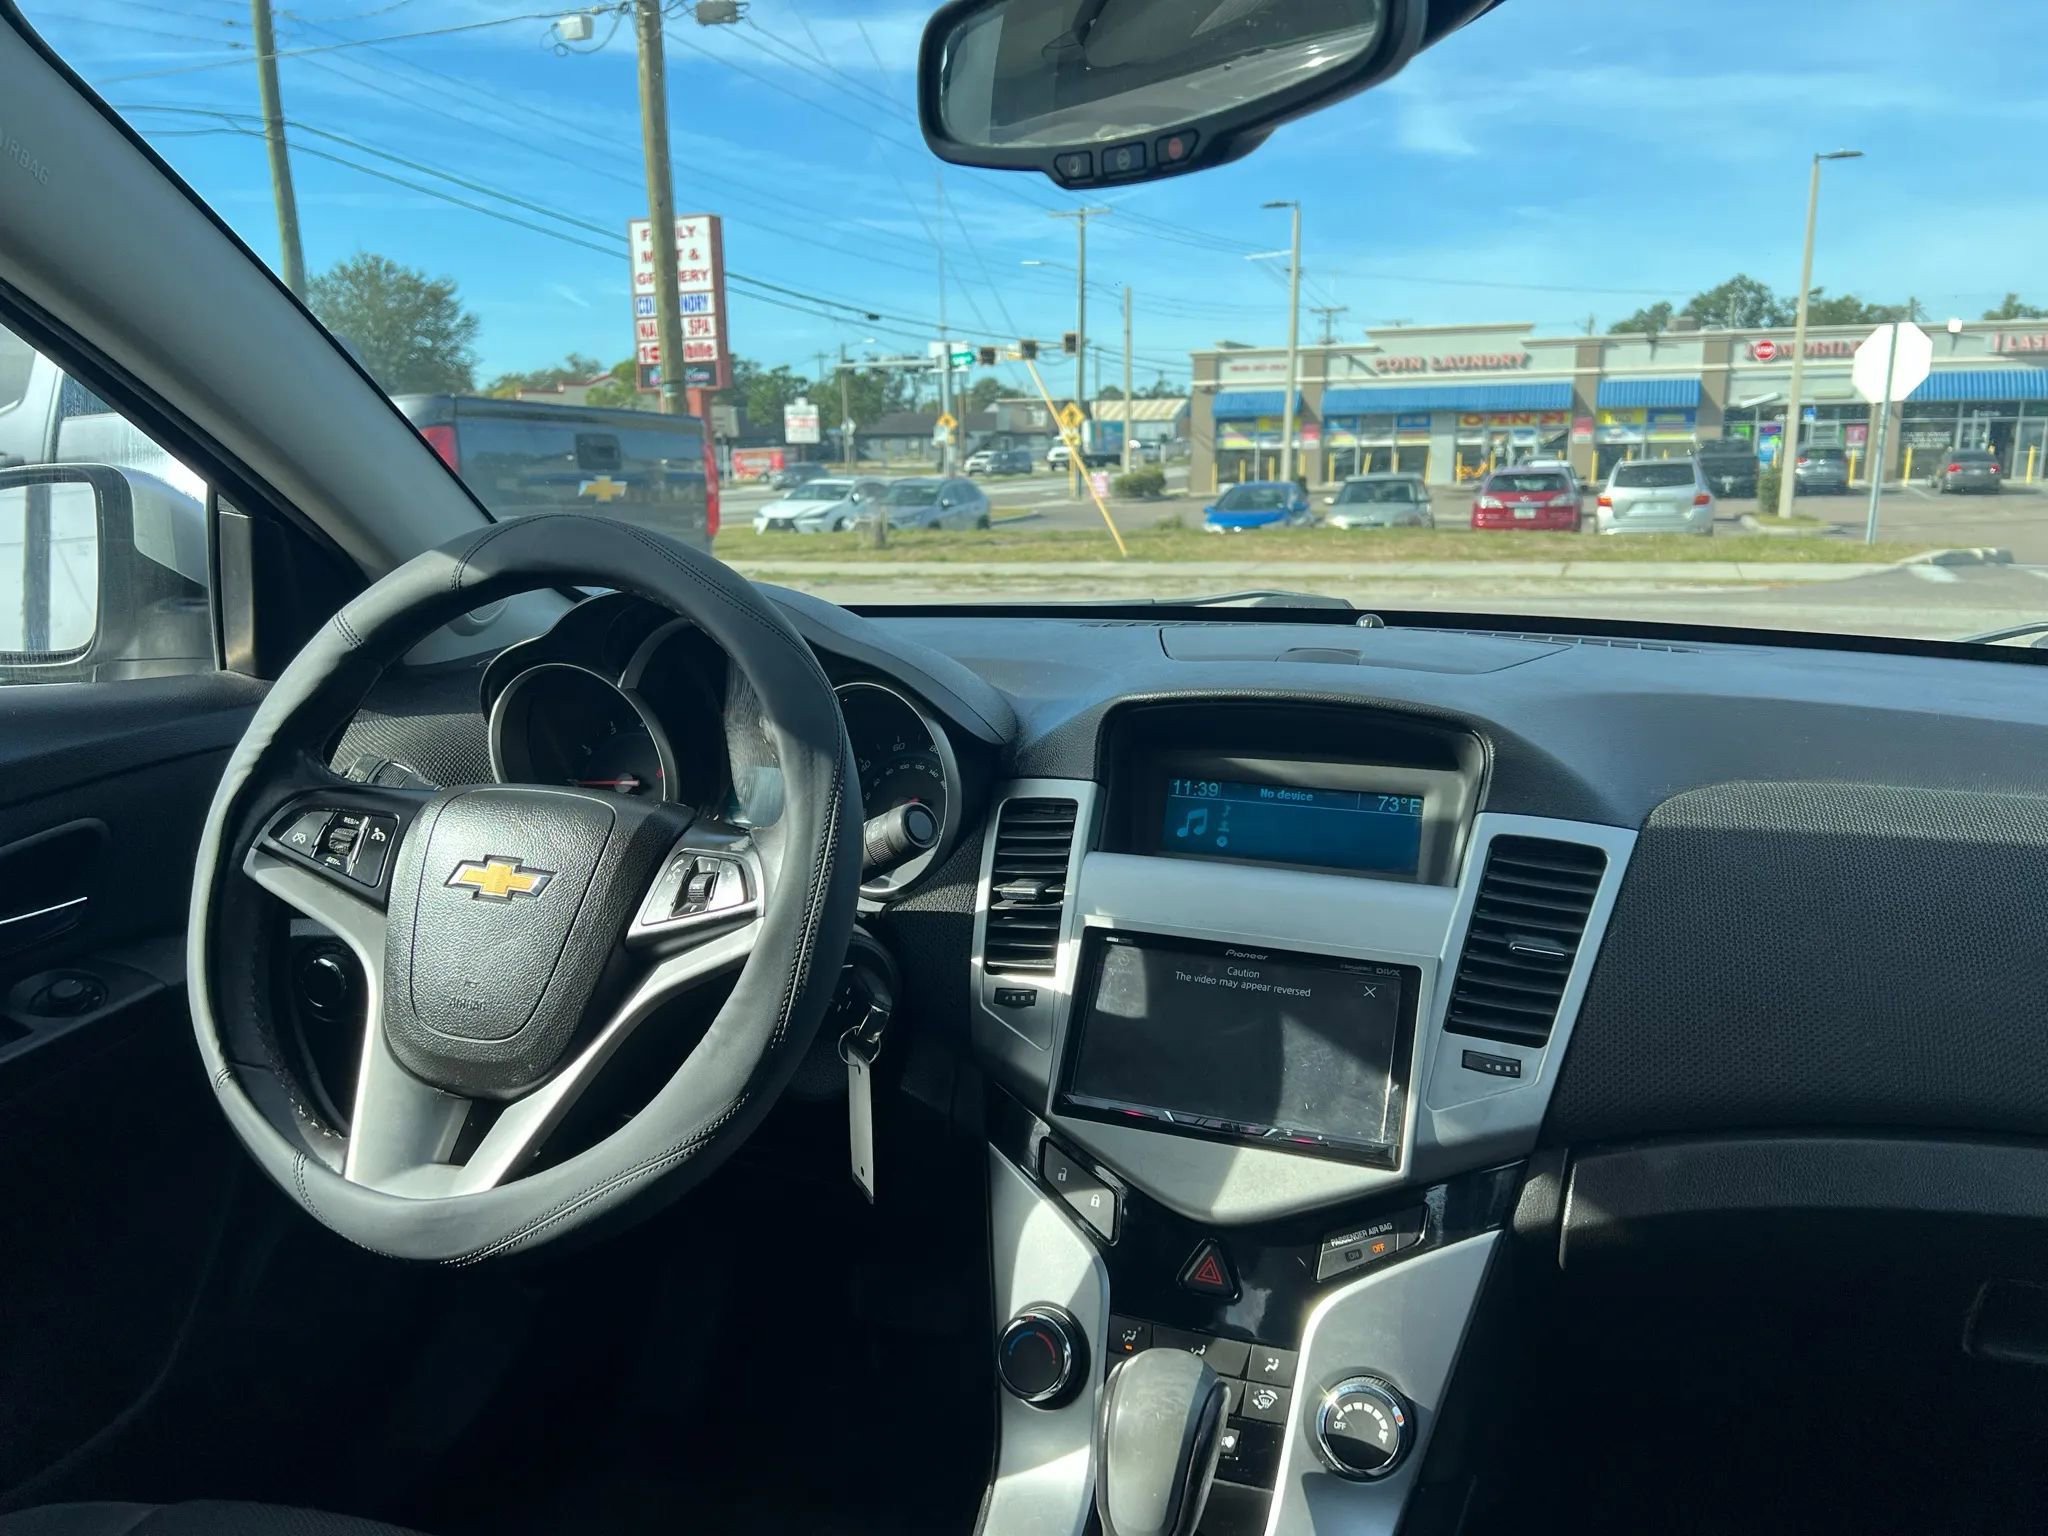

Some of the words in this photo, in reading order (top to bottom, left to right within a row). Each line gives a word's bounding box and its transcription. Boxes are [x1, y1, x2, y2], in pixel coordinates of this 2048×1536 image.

[641, 249, 683, 264] MT
[688, 248, 700, 262] &
[636, 269, 710, 285] GRERY
[2006, 334, 2048, 350] LAS
[1375, 356, 1422, 371] COIN
[1430, 352, 1525, 369] LAUNDRY
[1173, 779, 1219, 797] 11:39
[1260, 788, 1275, 799] No
[1277, 789, 1314, 802] device
[1225, 949, 1269, 960] Pioneer
[1227, 966, 1260, 979] Caution
[1175, 970, 1192, 982] The
[1193, 973, 1217, 985] video
[1219, 977, 1239, 991] may
[1240, 981, 1272, 995] appear
[1273, 985, 1312, 998] reversed
[1330, 1229, 1368, 1247] PASSENGER
[1368, 1226, 1379, 1236] AIR
[1379, 1222, 1393, 1233] BAG
[1372, 1243, 1385, 1253] OFF
[1333, 1420, 1347, 1430] OFF
